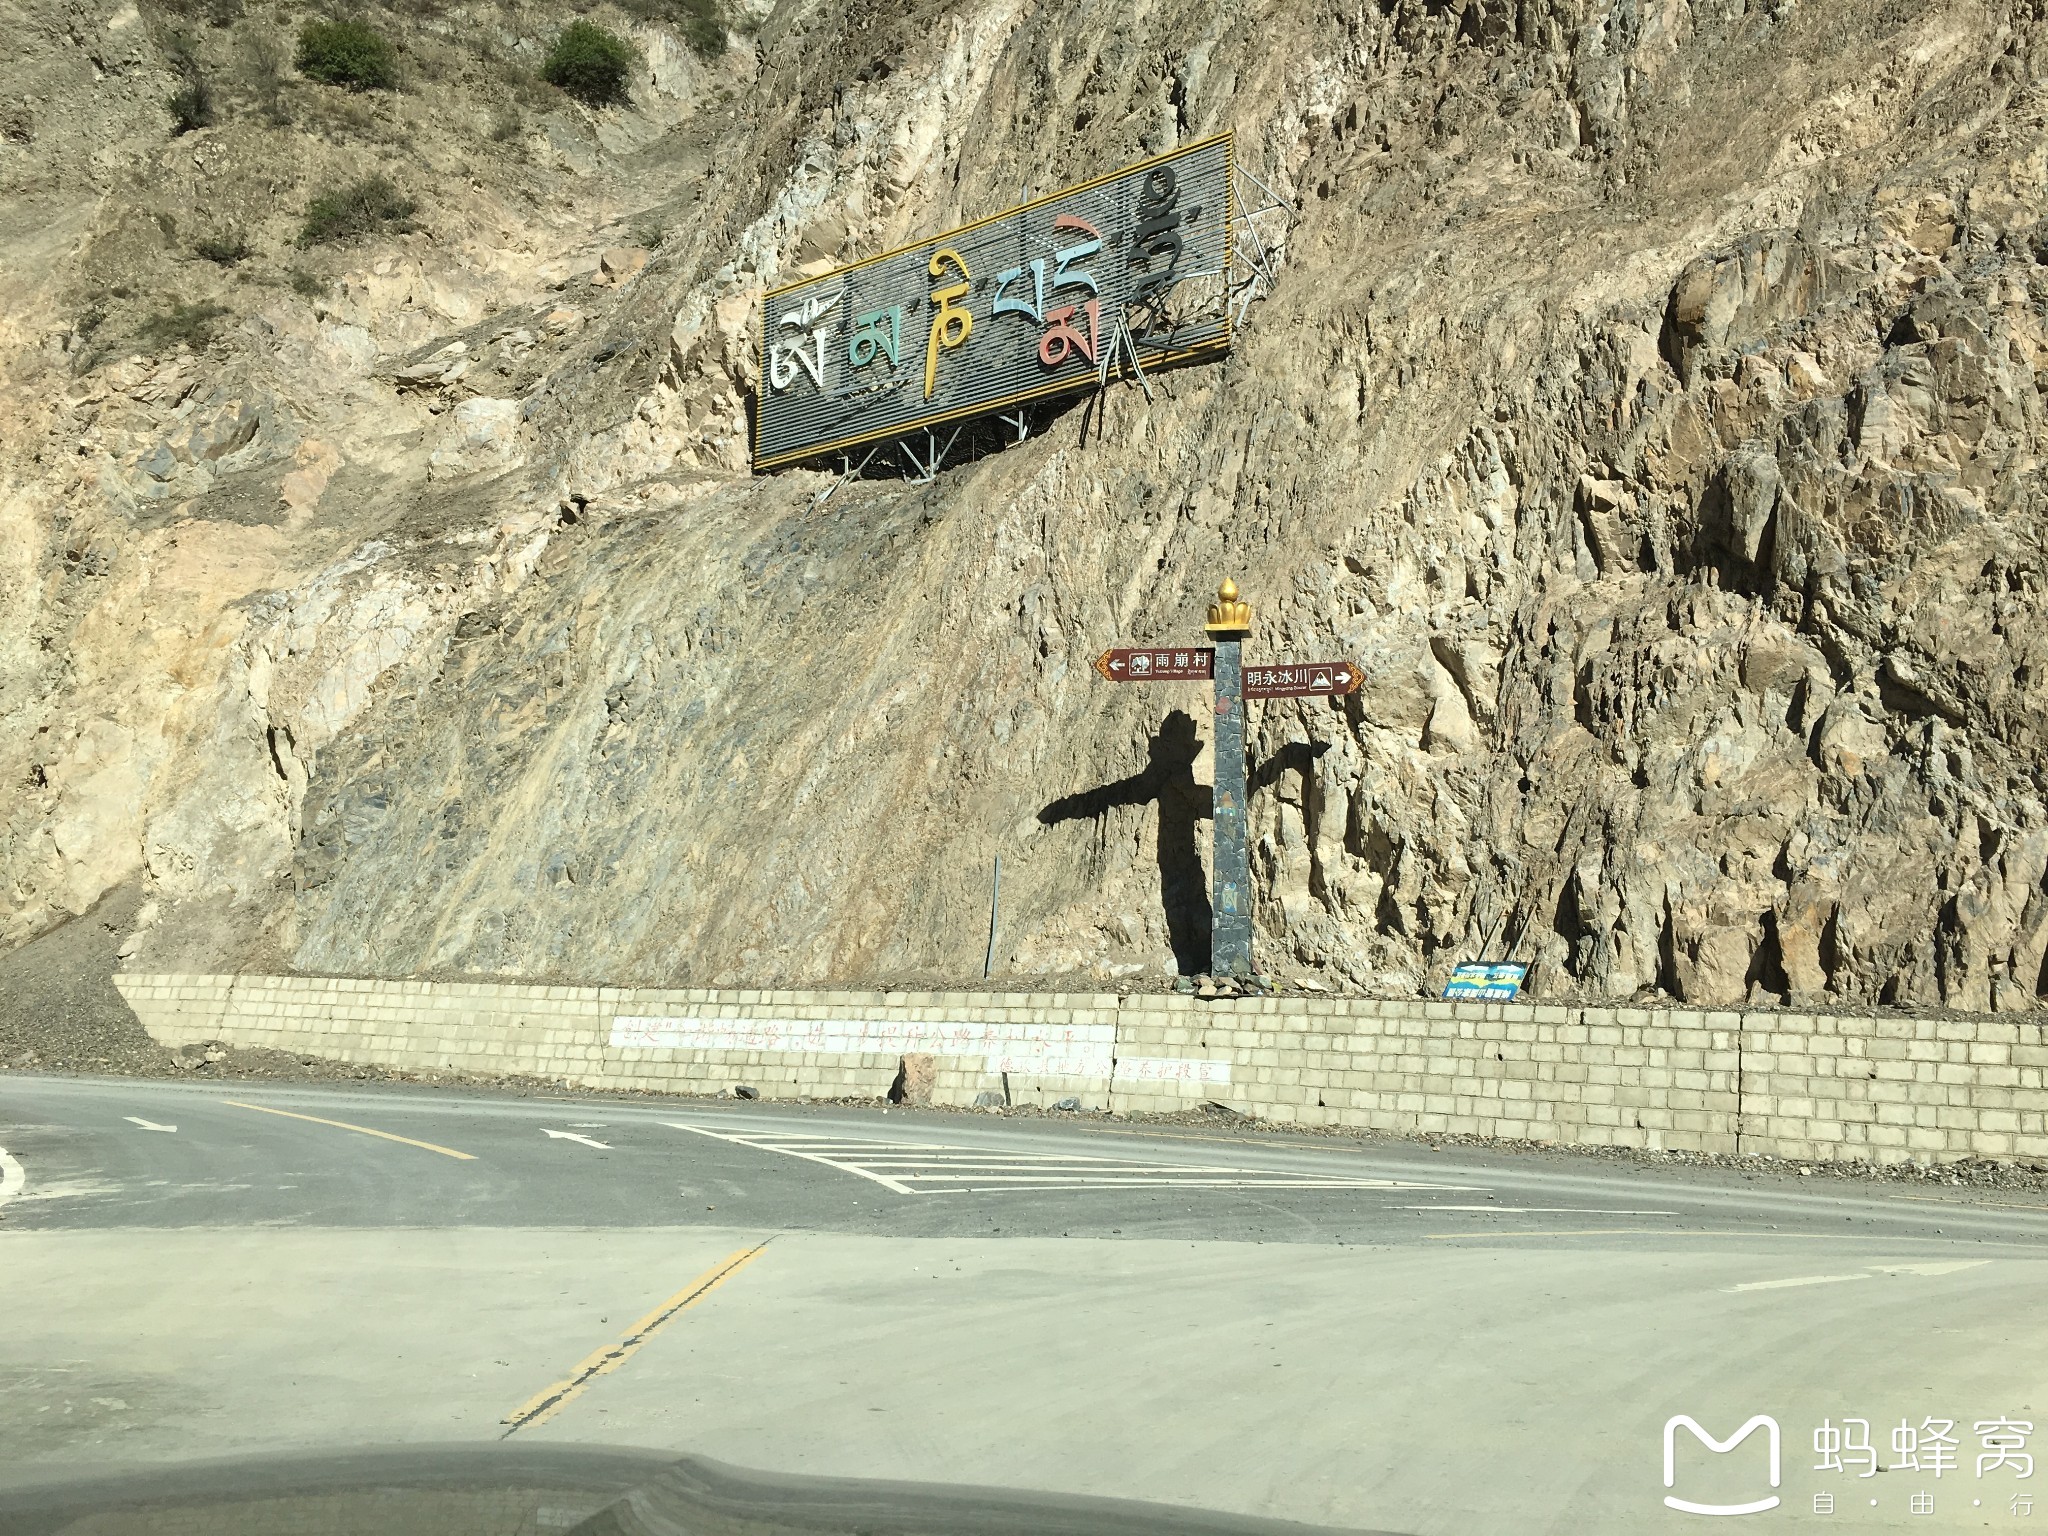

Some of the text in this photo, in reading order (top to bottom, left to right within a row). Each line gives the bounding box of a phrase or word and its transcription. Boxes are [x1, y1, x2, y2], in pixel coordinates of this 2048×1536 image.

[1155, 652, 1208, 668] 雨崩村
[1247, 668, 1308, 686] 明永冰川
